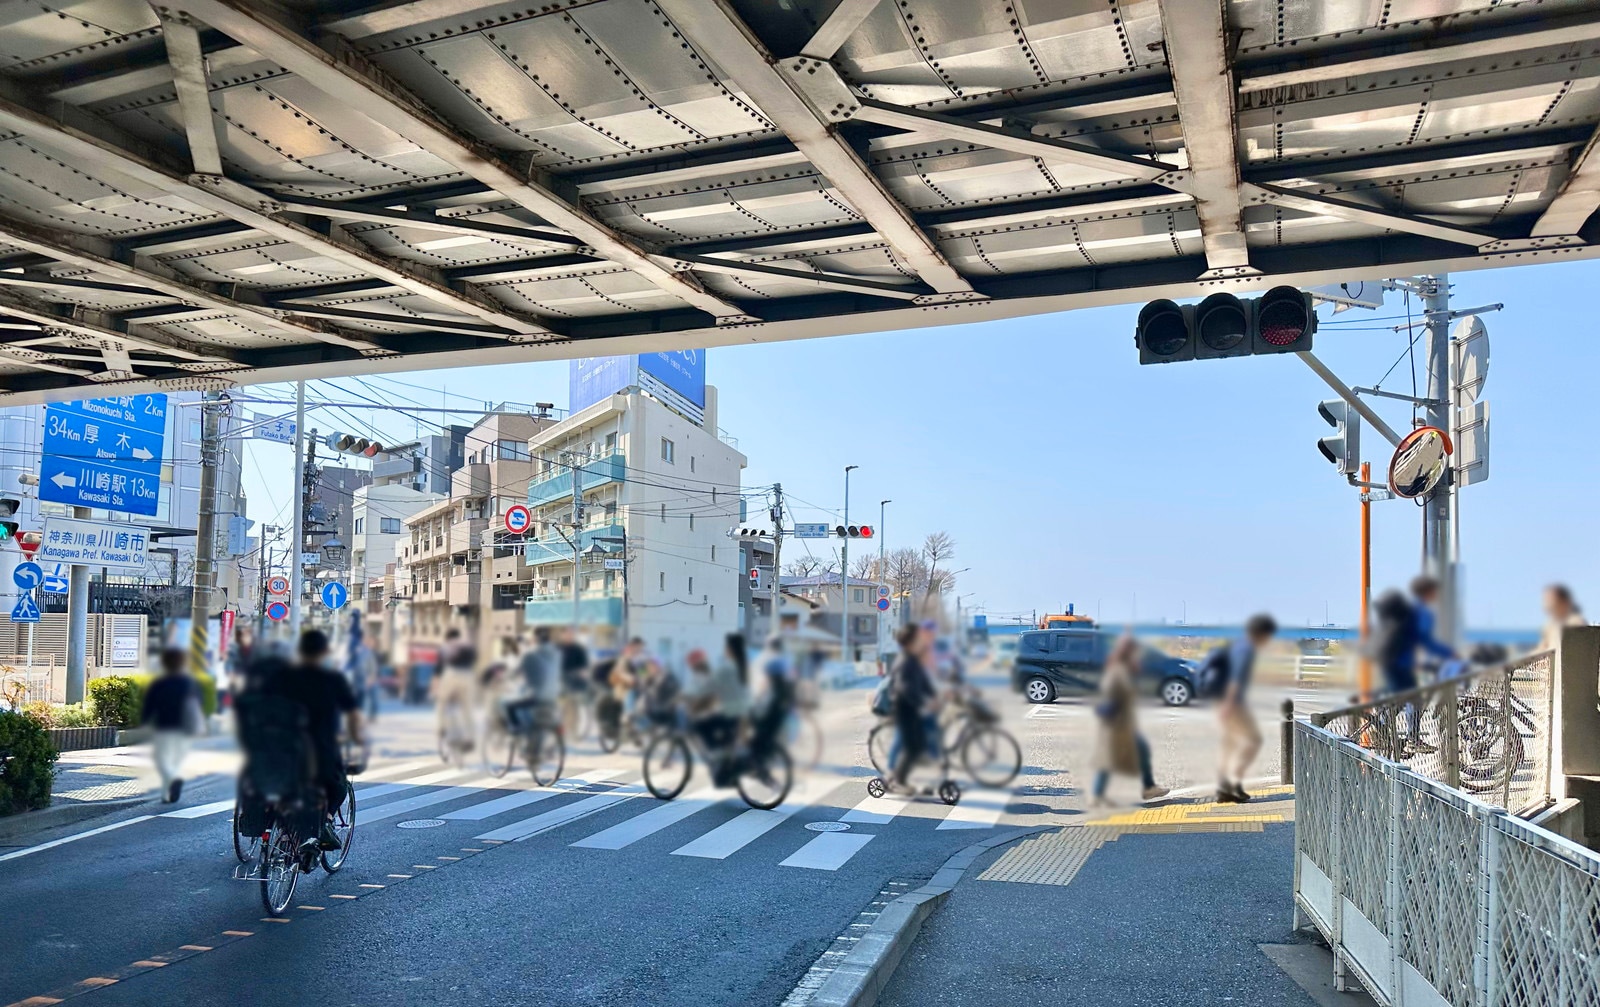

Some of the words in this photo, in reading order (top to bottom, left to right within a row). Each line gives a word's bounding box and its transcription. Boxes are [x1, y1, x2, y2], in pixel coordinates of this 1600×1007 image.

[82, 399, 123, 419] Mizonokuchi
[124, 409, 137, 422] Sta.
[48, 415, 81, 442] 34Km
[83, 423, 132, 451] 厚木
[260, 429, 279, 439] Futako
[95, 447, 117, 463] Atsugi
[79, 468, 127, 494] 川崎駅
[130, 477, 156, 499] 13Km
[78, 489, 111, 504] Kawasaki
[112, 494, 125, 506] Sta.
[48, 529, 97, 547] 神奈川県
[98, 529, 146, 552] 川崎市
[42, 545, 80, 559] Kanagawa
[82, 548, 98, 560] Pref.
[100, 550, 131, 562] Kawasaki
[132, 553, 146, 565] City
[272, 580, 285, 590] 30
